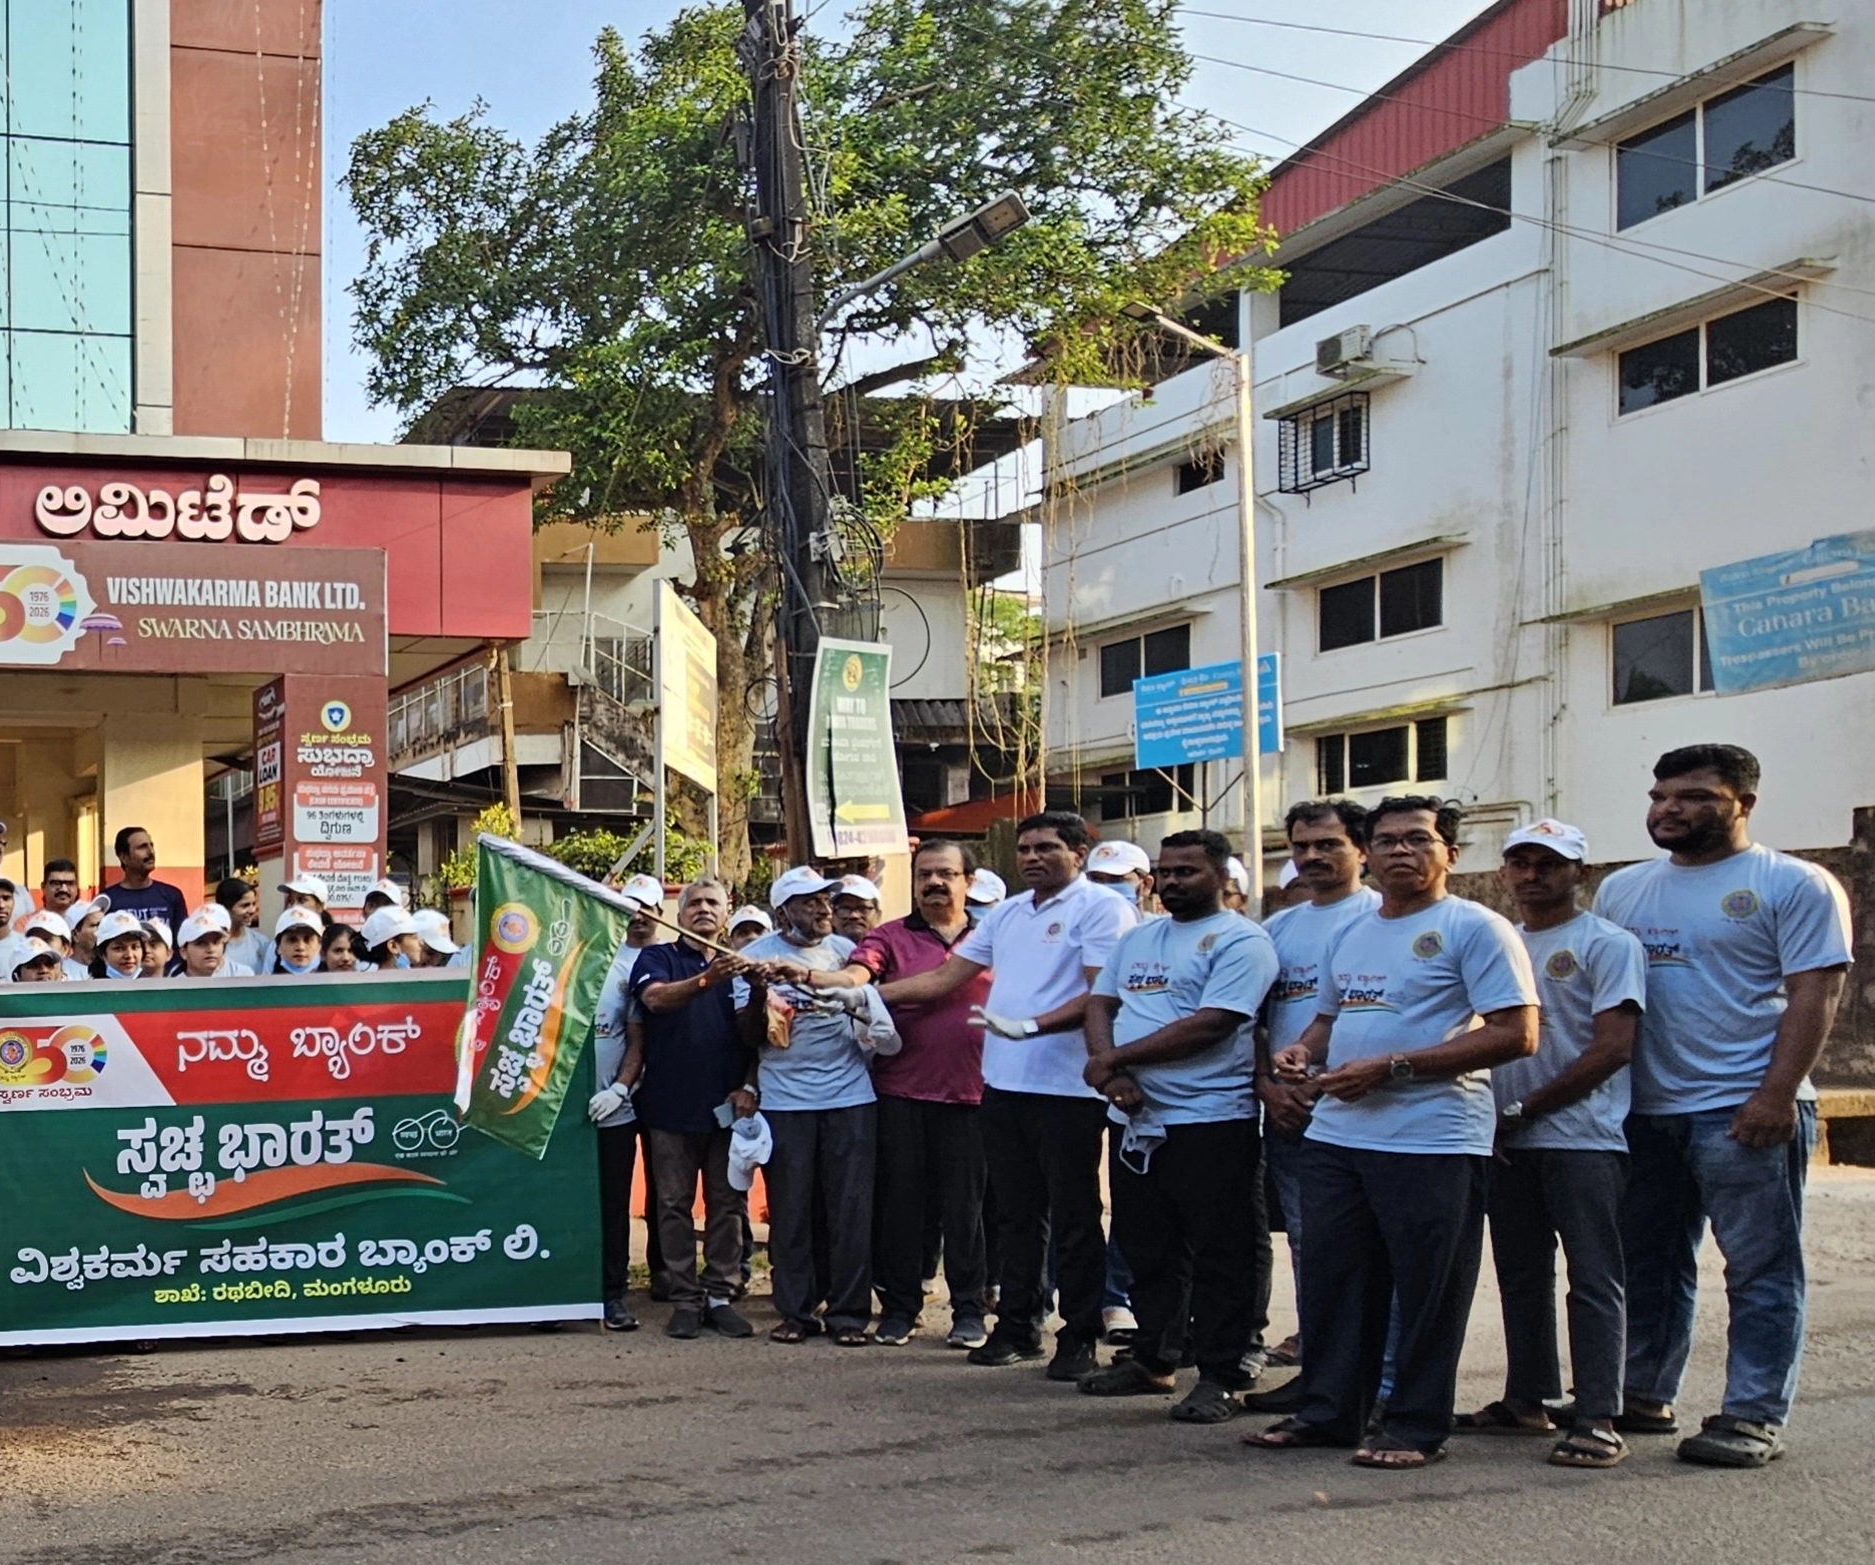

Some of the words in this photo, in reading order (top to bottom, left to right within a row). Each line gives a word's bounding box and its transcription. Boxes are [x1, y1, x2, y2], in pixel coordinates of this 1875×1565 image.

[34, 473, 323, 544] ಲಿಮಿಟೆಡ್
[29, 591, 49, 602] 1976
[106, 577, 261, 607] VISHWAKARMA
[265, 581, 321, 609] BANK
[324, 582, 366, 610] LTD.
[1732, 601, 1763, 615] This
[1766, 588, 1828, 610] Property
[29, 607, 50, 617] 2026
[1738, 605, 1834, 638] Canara
[1841, 597, 1875, 618] Ba
[138, 618, 233, 640] SWARNA
[237, 619, 365, 645] SAMBHRAMA
[1720, 644, 1802, 667] Trespassers
[262, 747, 276, 763] CAR
[259, 763, 278, 783] LOAN
[307, 811, 317, 820] 96
[70, 1044, 86, 1053] 1976
[70, 1057, 86, 1065] 2026
[177, 1028, 269, 1082] ನಮ್ಮ
[289, 1015, 421, 1080] ಬ್ಯಾಂಕ್
[39, 1086, 92, 1101] ಸಂಭ್ರಮ
[116, 1115, 215, 1205] ಸ್ವಚ್ಛ
[218, 1106, 375, 1184] ಭಾರತ್
[10, 1243, 188, 1290] ವಿಶ್ವಕರ್ಮ
[199, 1232, 347, 1274] ಸಹಕಾರ
[358, 1227, 494, 1274] ಬ್ಯಾಂಕ್
[502, 1223, 551, 1262] ಲಿ.
[154, 1285, 207, 1304] ಶಾಖೆ:
[213, 1280, 298, 1303] ರಥಬೀದಿ,
[303, 1275, 412, 1299] ಮಂಗಳೂರು
